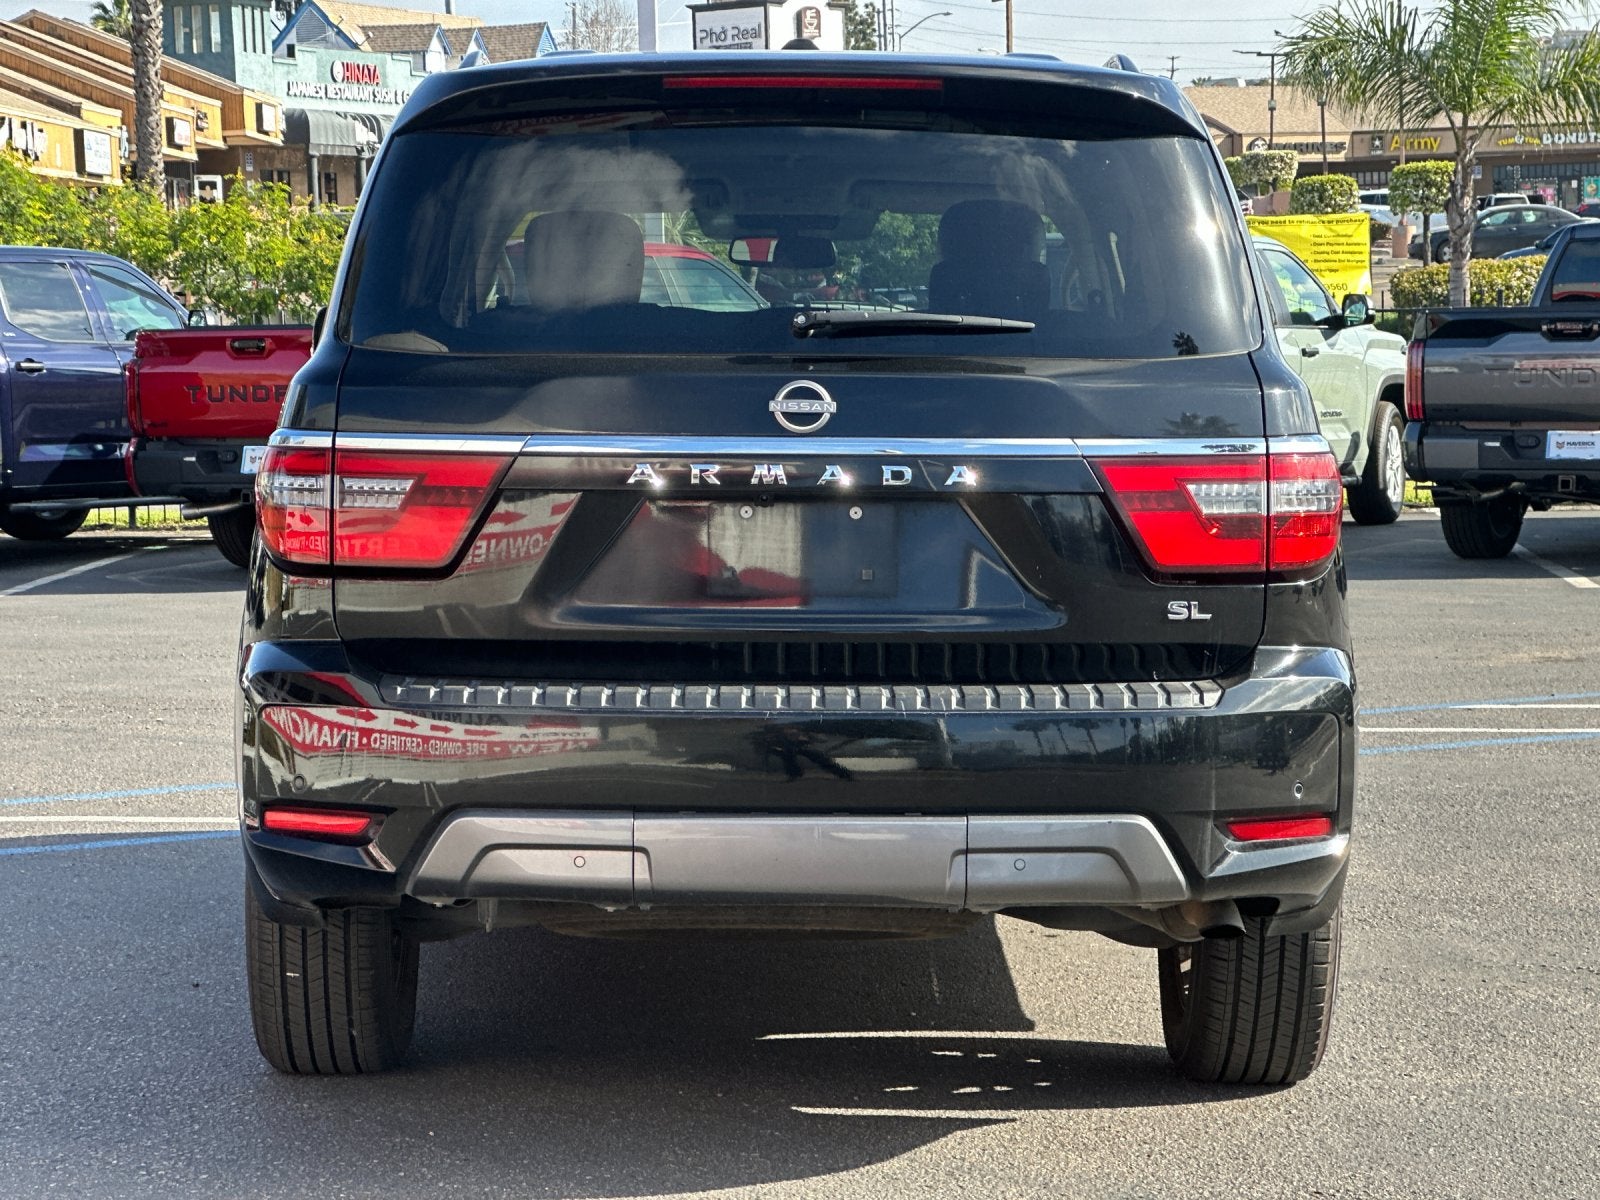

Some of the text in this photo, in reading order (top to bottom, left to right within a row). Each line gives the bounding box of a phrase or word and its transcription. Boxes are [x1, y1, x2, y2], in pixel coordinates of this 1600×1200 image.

[731, 22, 762, 41] Real
[287, 80, 325, 100] JAPANESE
[325, 84, 373, 102] RESTAURANT
[373, 87, 392, 104] SUSHI
[1390, 135, 1441, 152] Army
[770, 402, 834, 411] NISSAN
[626, 463, 977, 487] ARMADA
[1167, 601, 1212, 620] SL
